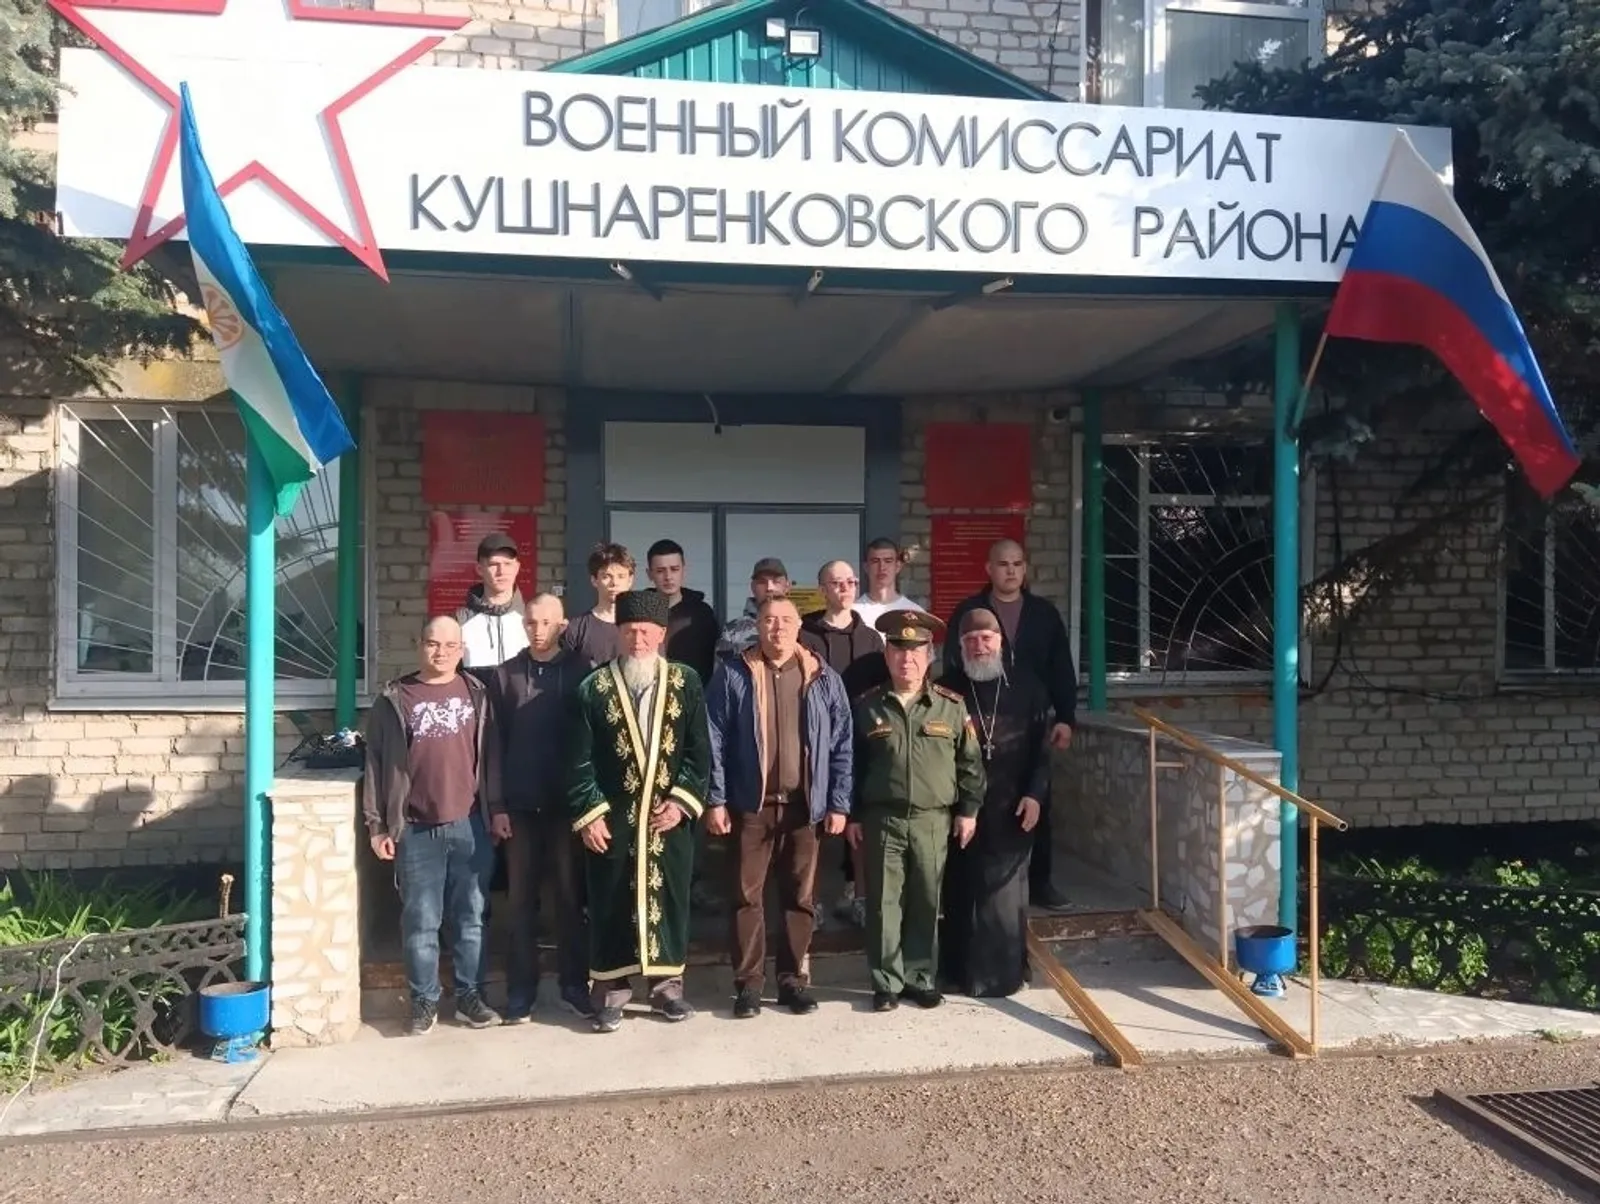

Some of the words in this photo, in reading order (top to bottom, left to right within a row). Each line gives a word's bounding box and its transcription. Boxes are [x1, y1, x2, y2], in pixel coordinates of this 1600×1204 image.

[522, 91, 810, 160] ВОЕННЫЙ
[835, 109, 1281, 183] КОМИССАРИАТ
[410, 174, 1087, 255] КУШНАРЕНКОВСКОГО
[1133, 201, 1363, 263] РАЙОНА
